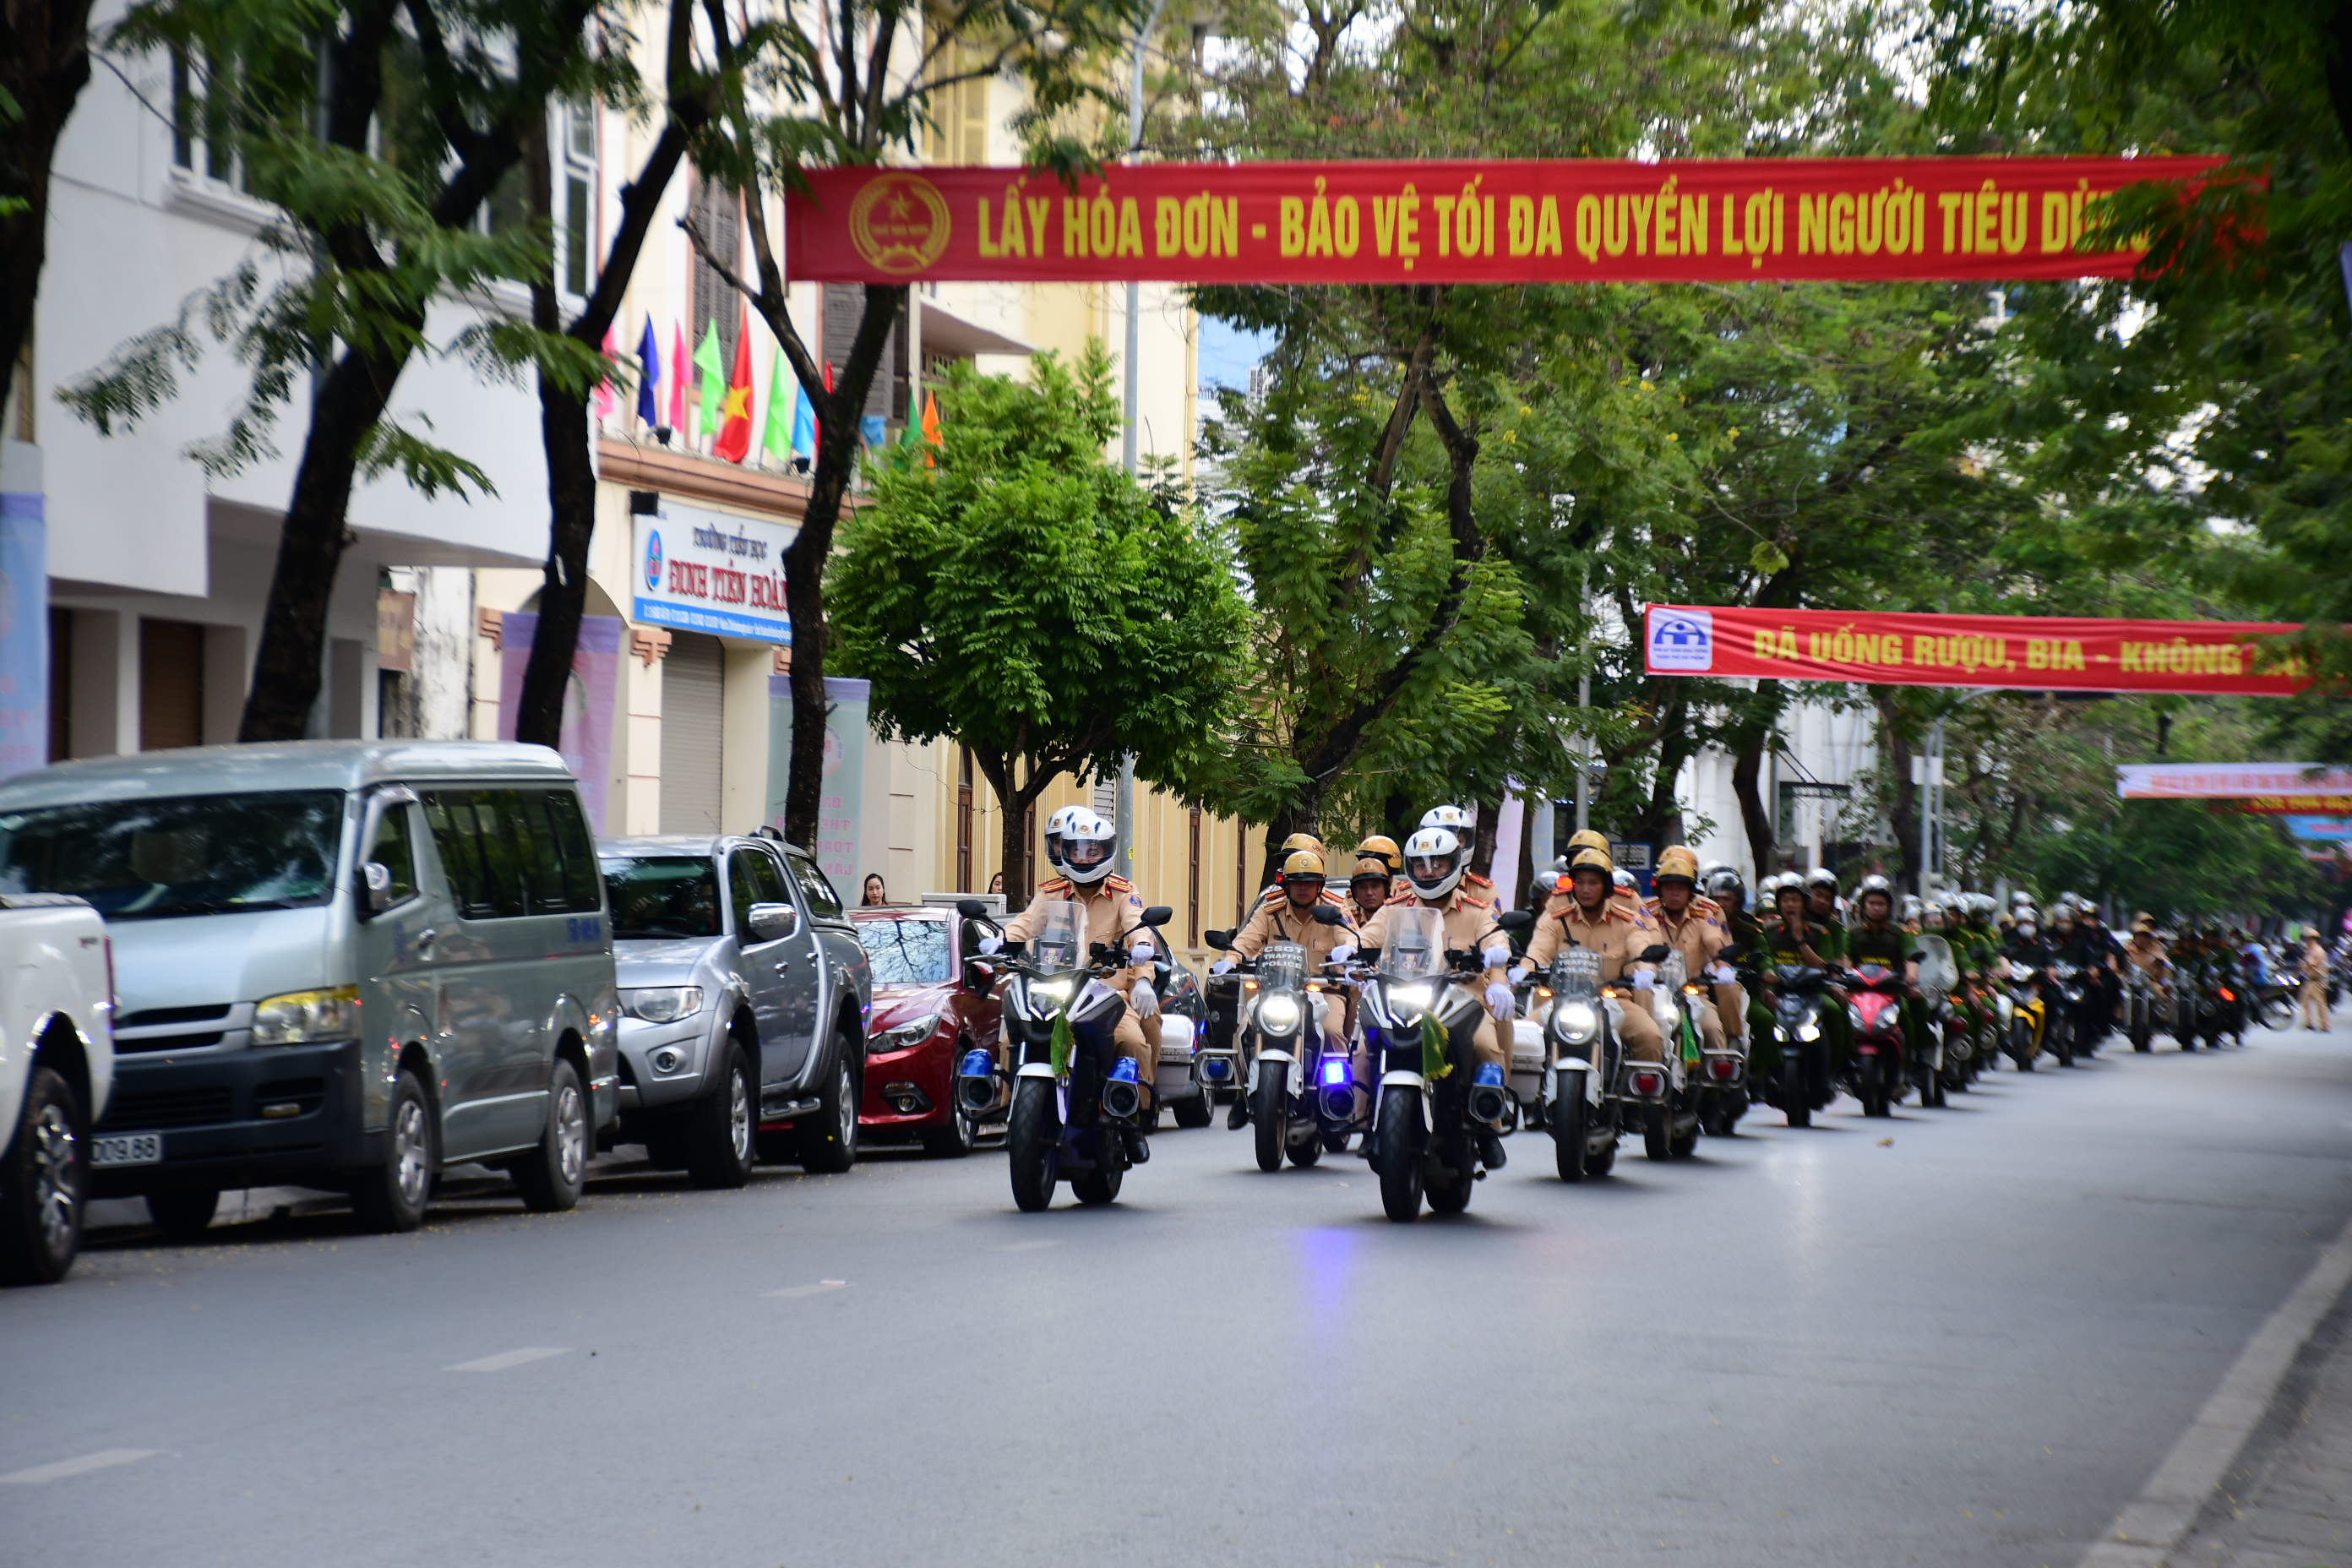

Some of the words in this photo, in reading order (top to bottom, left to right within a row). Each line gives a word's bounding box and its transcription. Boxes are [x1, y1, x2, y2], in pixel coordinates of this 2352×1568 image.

[979, 174, 1050, 258] LẤY
[1064, 183, 1144, 258] HÓA
[1154, 189, 1239, 259] ĐƠN
[1280, 176, 1360, 258] BẢO
[1372, 183, 1421, 270] VỆ
[1433, 174, 1495, 257] TỐI
[1507, 194, 1563, 257] ĐA
[1576, 173, 1709, 264] QUYỀN
[1722, 187, 1785, 269] LỢI
[1797, 177, 1926, 255] NGƯỜI
[1937, 178, 2029, 255] TIÊU
[1753, 625, 1799, 661] ĐÃ
[1809, 622, 1903, 666] UỐNG
[1913, 634, 2017, 674] RƯỢU,
[2025, 638, 2087, 671] BIA
[2120, 635, 2244, 676] KHÔNG
[1263, 945, 1305, 954] CSGT
[1263, 953, 1304, 961] TRAFFIC
[1261, 960, 1302, 970] POLICE
